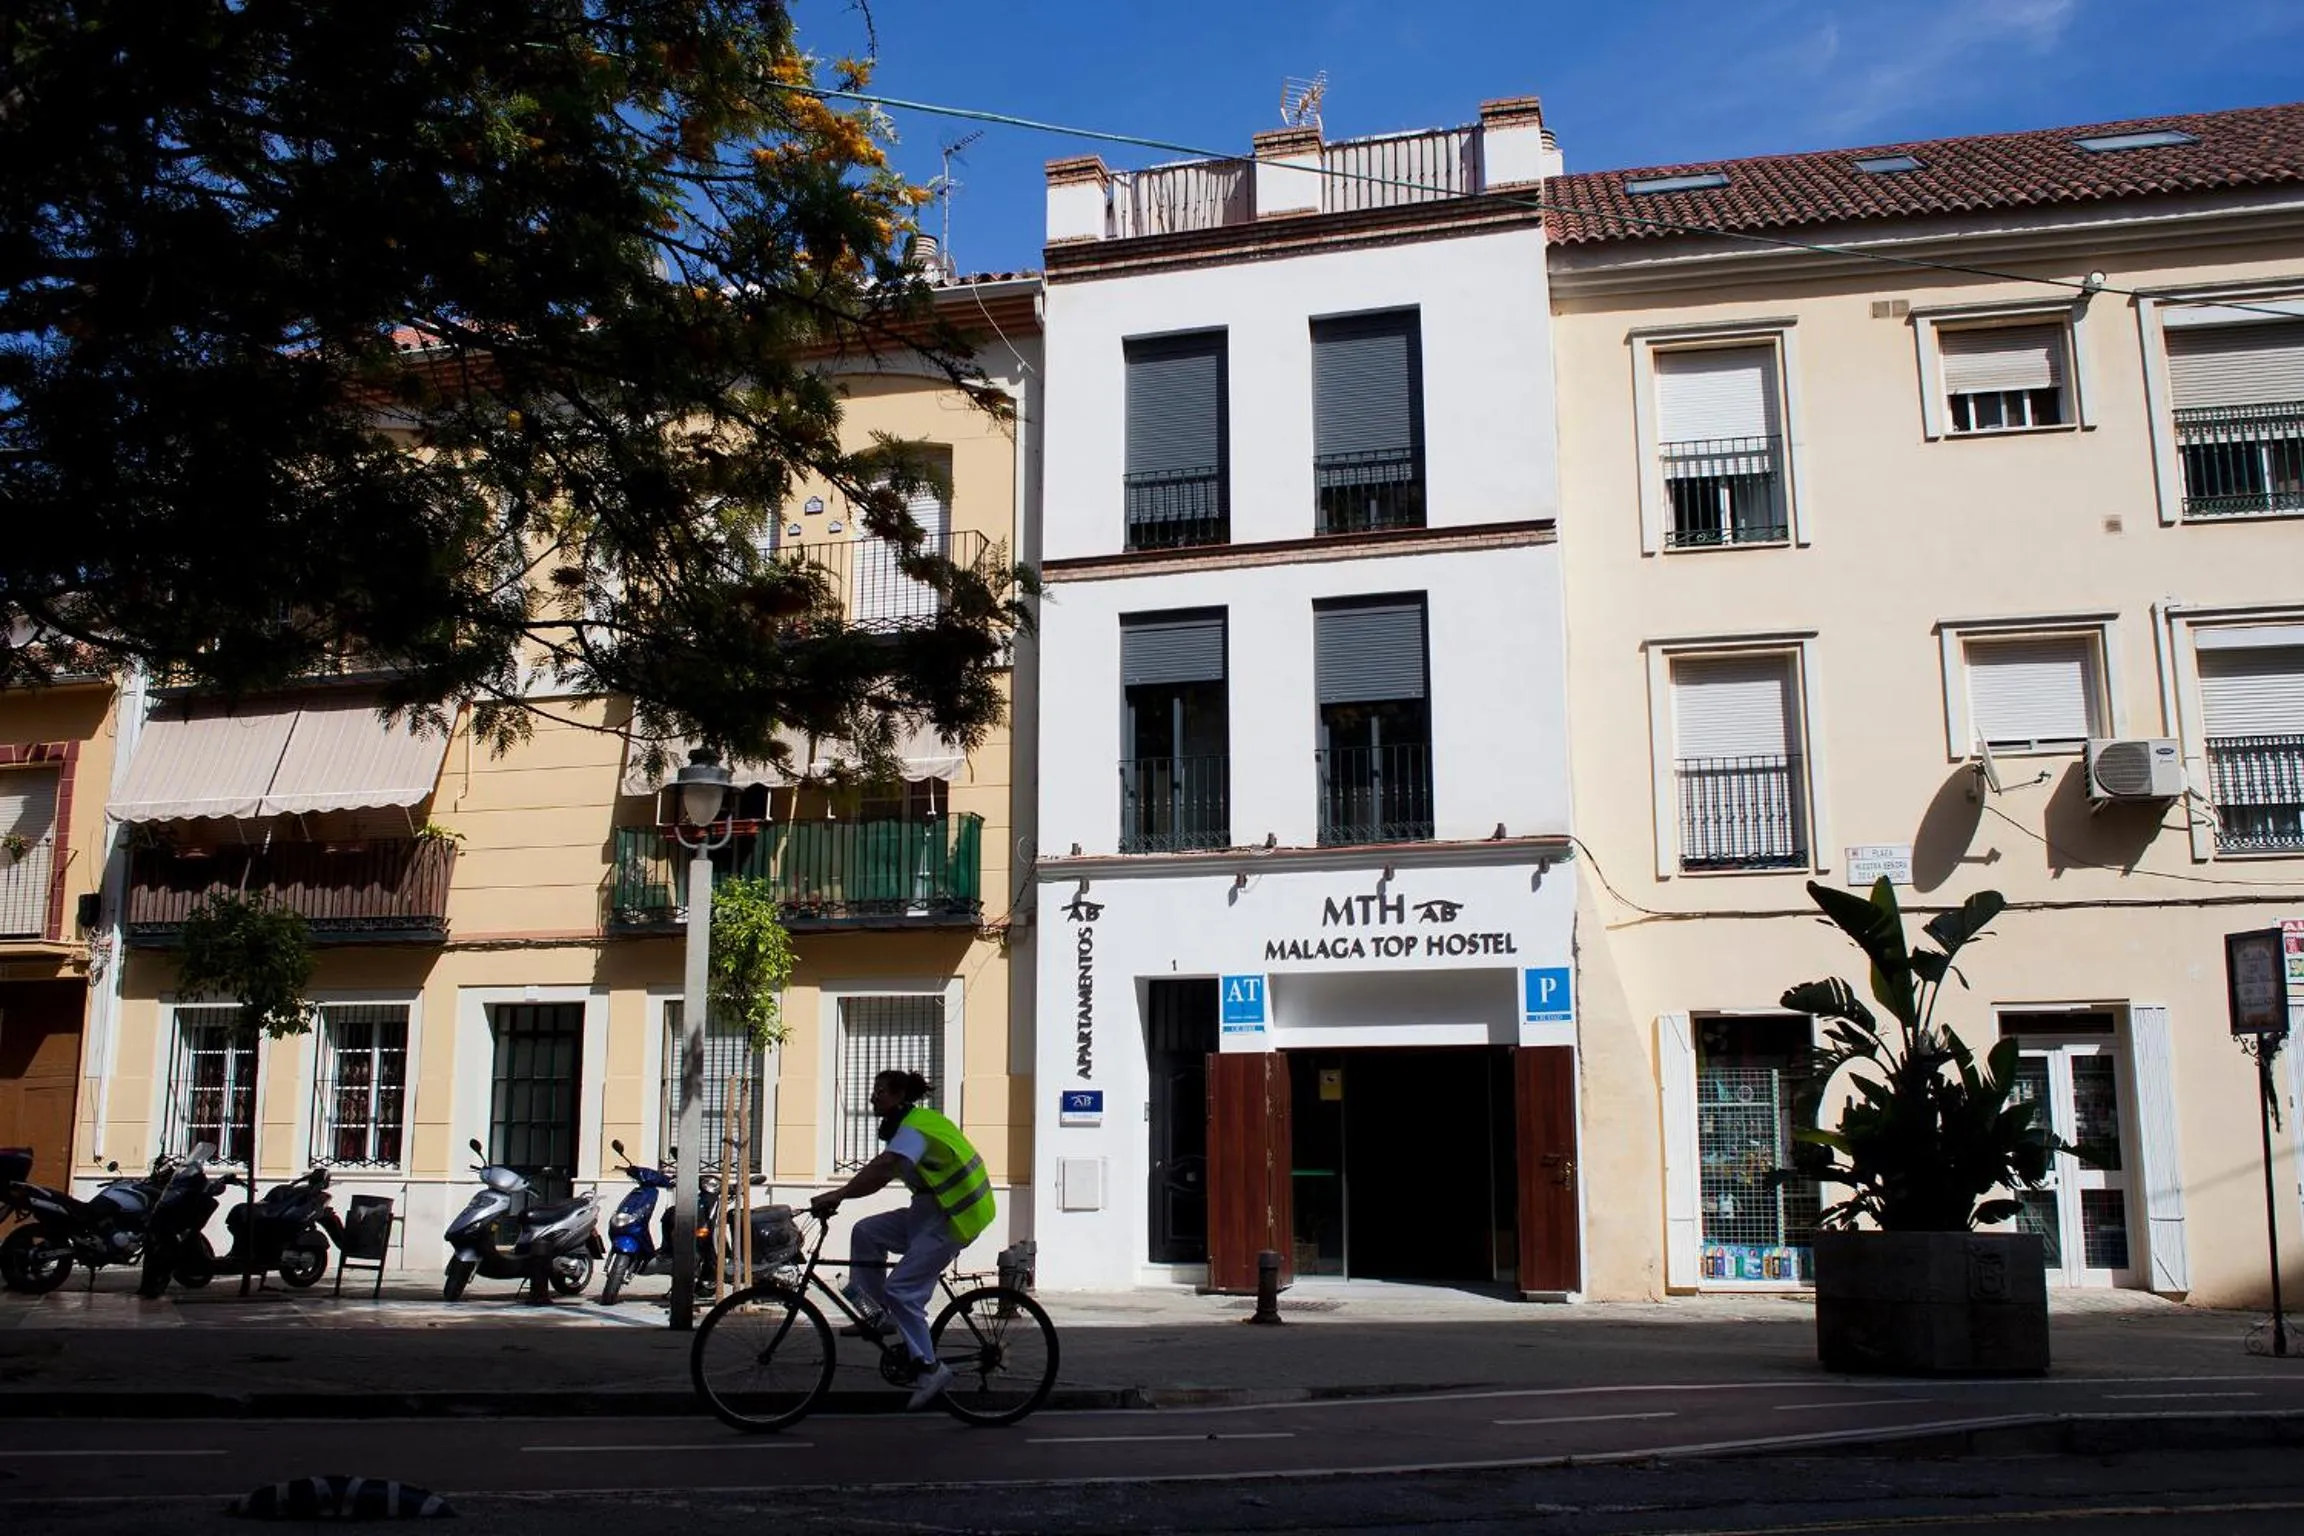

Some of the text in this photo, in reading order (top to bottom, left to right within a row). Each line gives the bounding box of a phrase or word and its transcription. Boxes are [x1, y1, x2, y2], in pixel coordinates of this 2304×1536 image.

[1872, 848, 1893, 858] PLAZA
[1061, 902, 1104, 922] AB
[1323, 894, 1464, 927] MTH AB
[1265, 933, 1518, 960] MALAGA TOP HOSTEL
[1171, 958, 1177, 971] 1
[1226, 978, 1260, 1003] AT
[1539, 977, 1557, 1004] P
[1076, 926, 1093, 1081] APARTAMENTOS
[1072, 1095, 1093, 1107] AB
